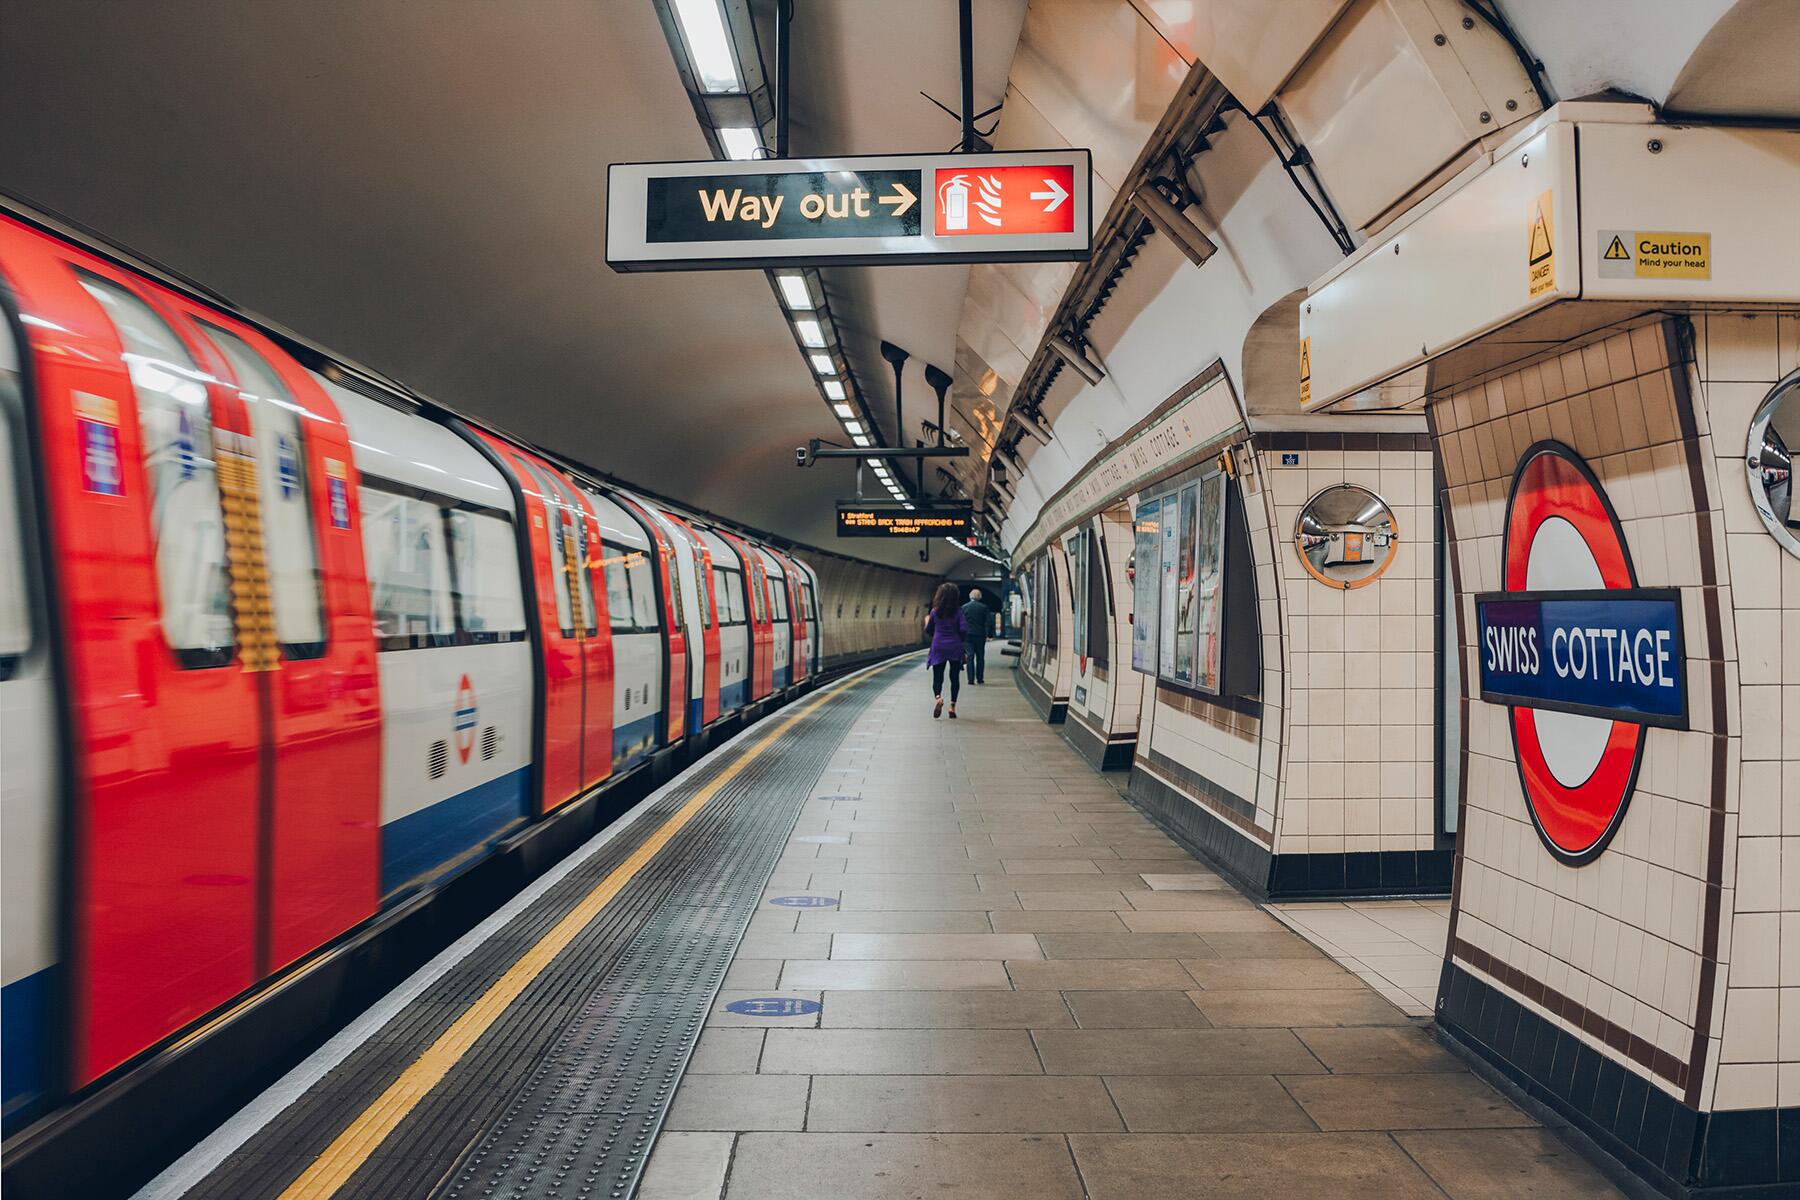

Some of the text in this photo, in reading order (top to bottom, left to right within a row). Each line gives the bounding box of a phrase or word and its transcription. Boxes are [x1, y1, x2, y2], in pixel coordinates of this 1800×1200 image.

[698, 187, 871, 229] Way out
[1639, 240, 1702, 256] Caution
[1639, 259, 1706, 268] Mind your head
[1149, 426, 1180, 458] COTTAGE
[1486, 625, 1674, 688] SWISS COTTAGE
